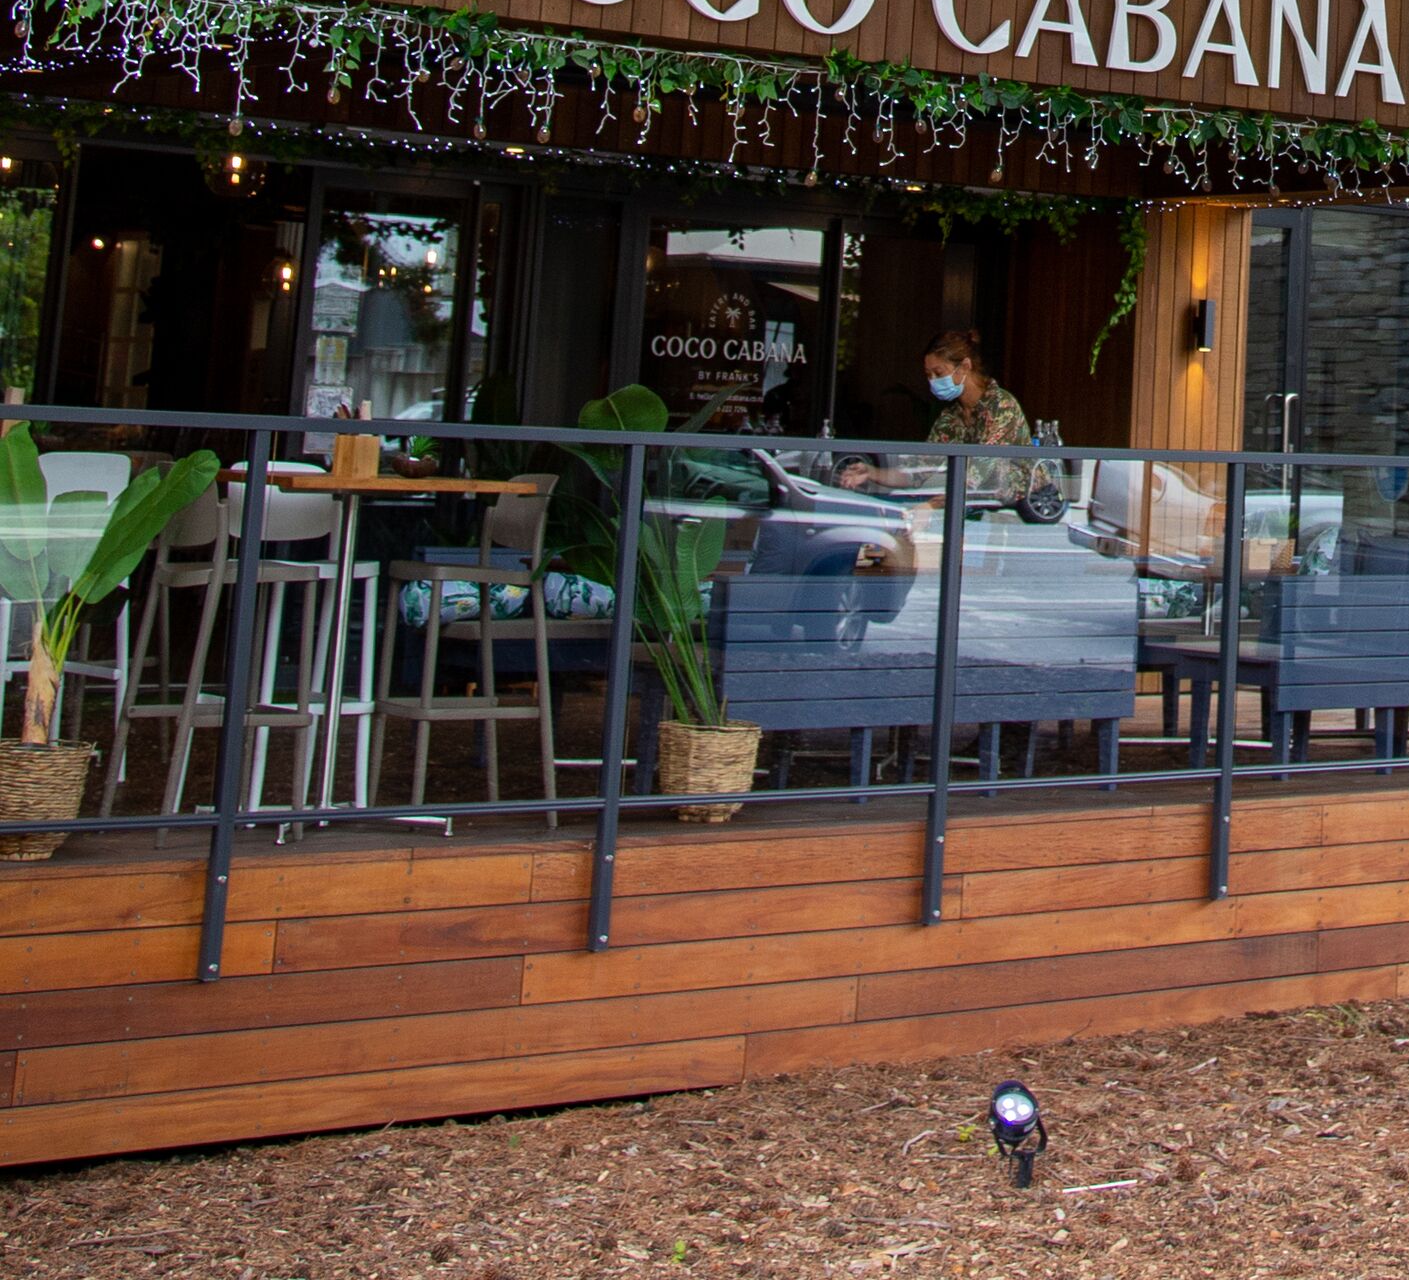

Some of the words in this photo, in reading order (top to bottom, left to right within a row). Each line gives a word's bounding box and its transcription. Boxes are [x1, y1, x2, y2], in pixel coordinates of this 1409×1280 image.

[708, 294, 728, 328] EATERY
[732, 292, 750, 307] AND
[748, 310, 756, 330] BAR
[651, 336, 717, 360] COCO
[723, 340, 807, 364] CABANA
[698, 371, 711, 380] BY
